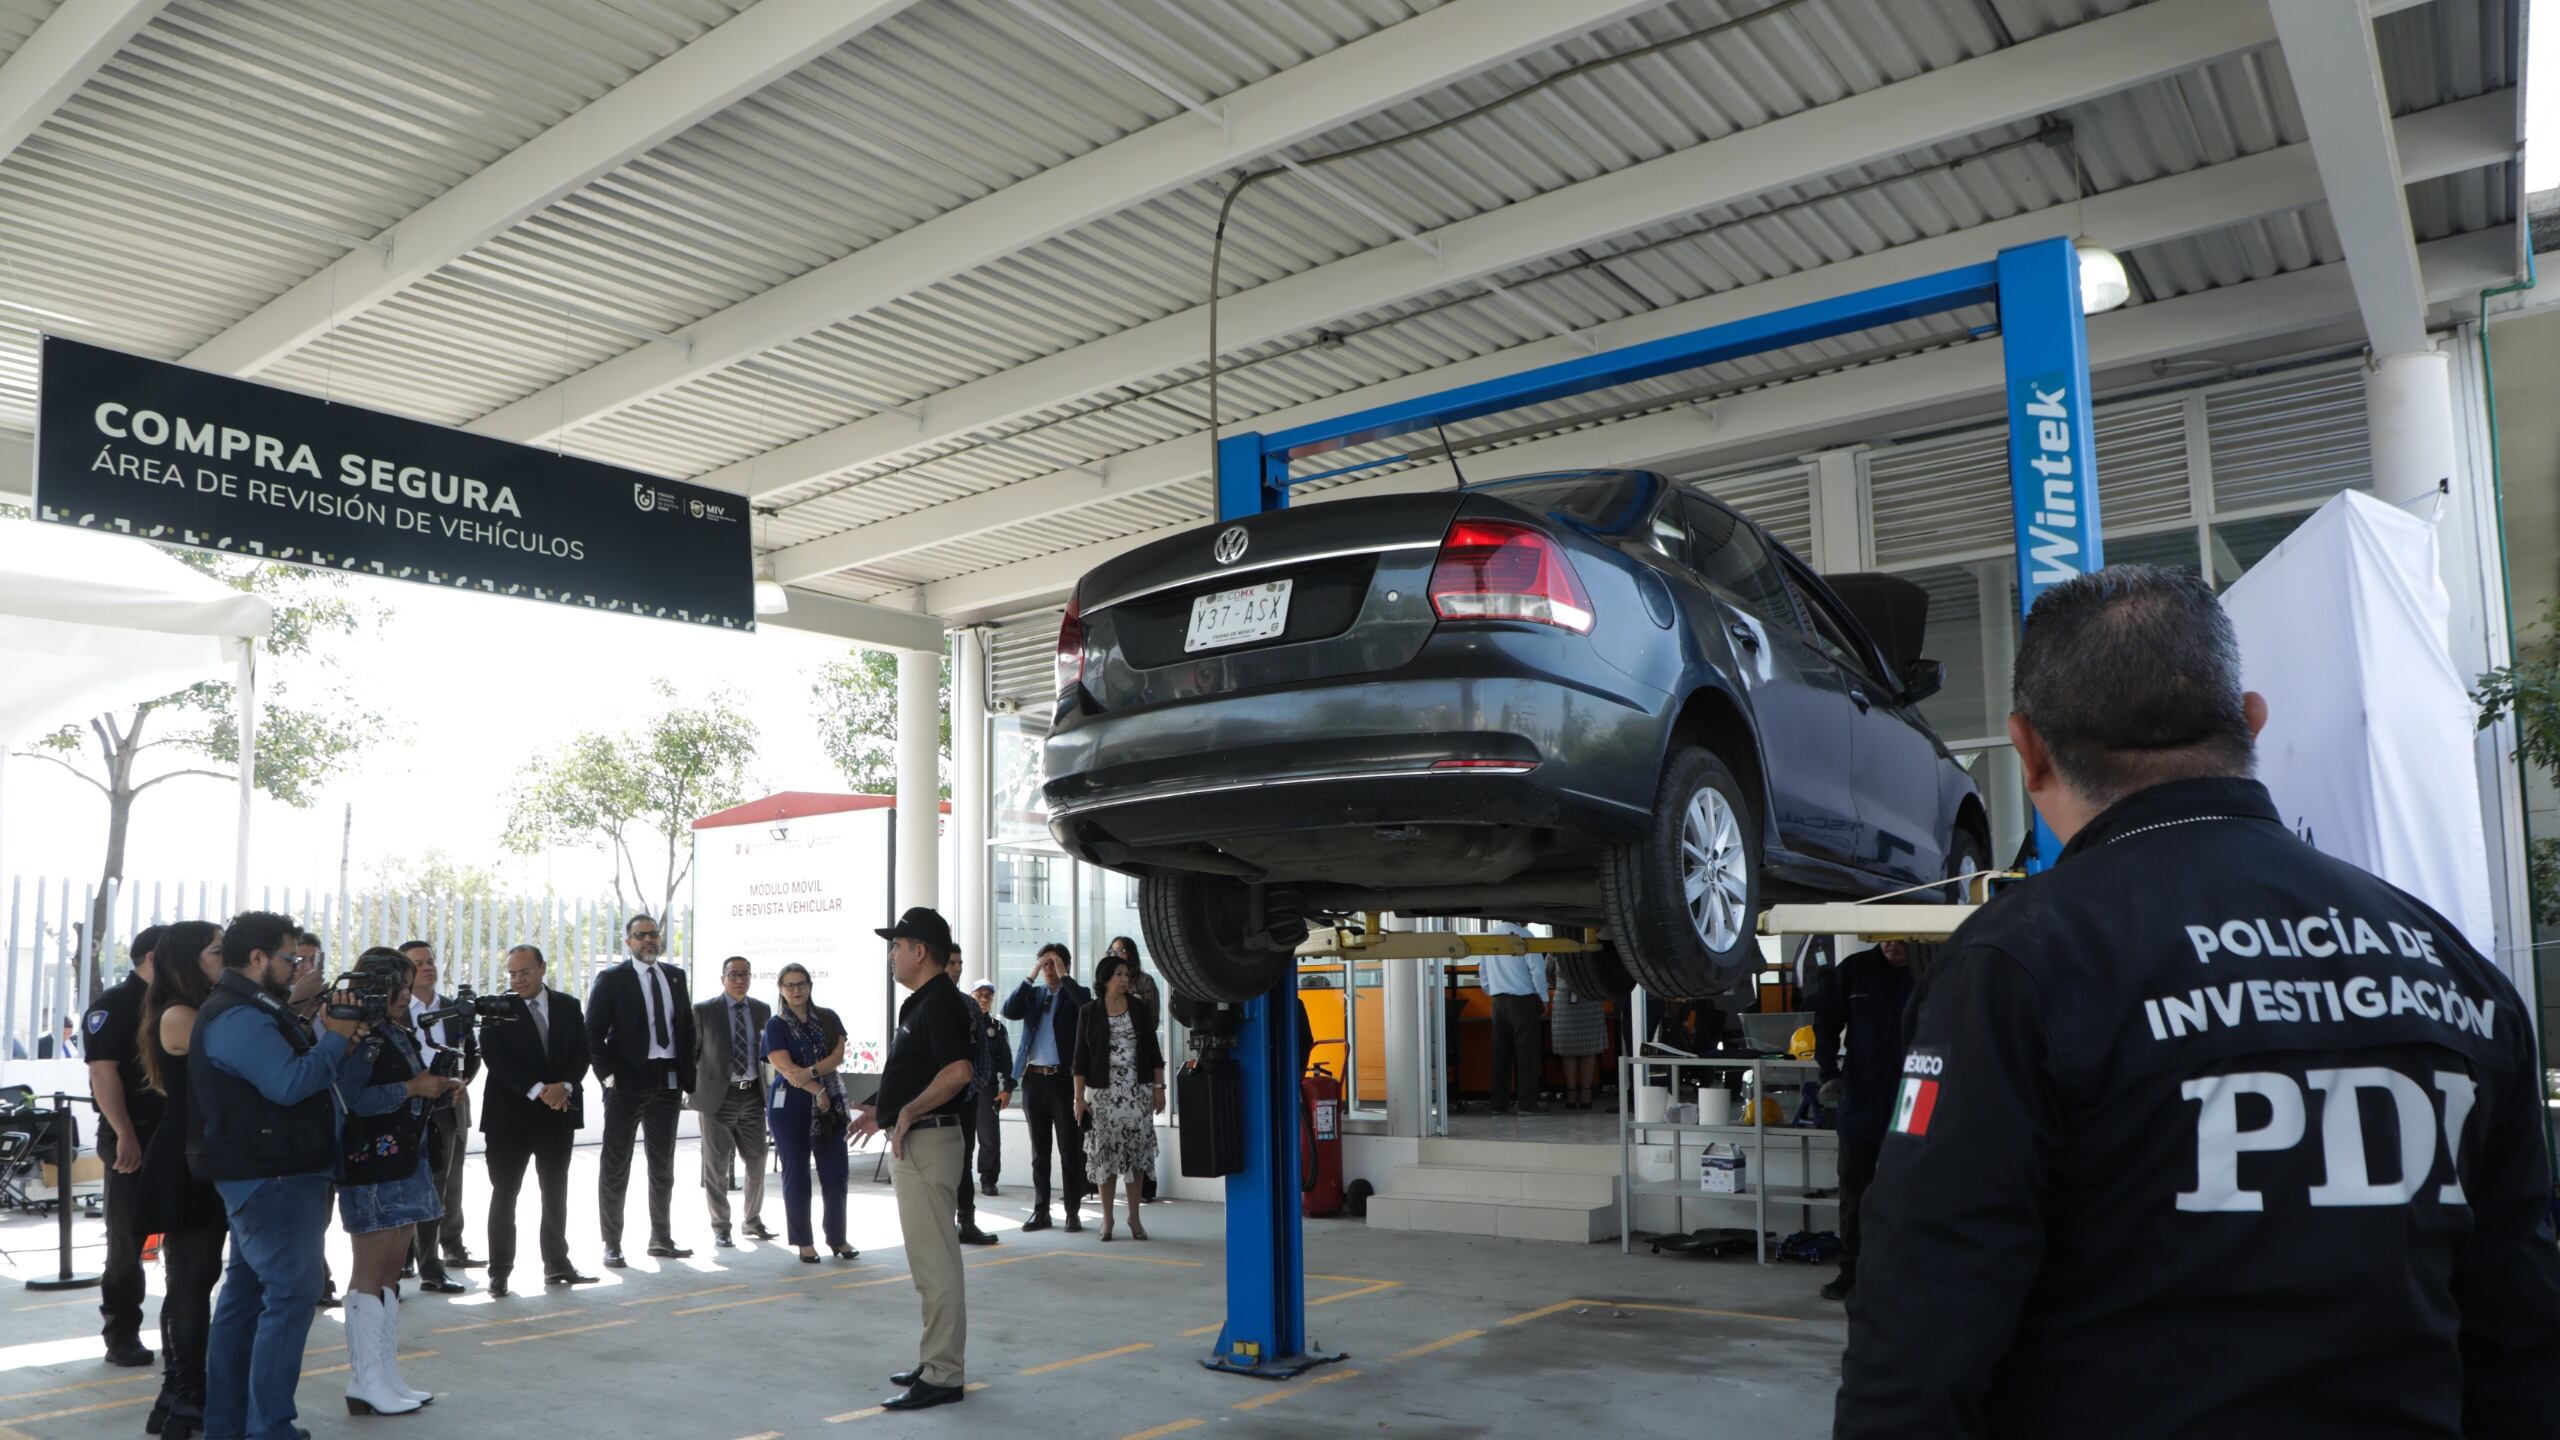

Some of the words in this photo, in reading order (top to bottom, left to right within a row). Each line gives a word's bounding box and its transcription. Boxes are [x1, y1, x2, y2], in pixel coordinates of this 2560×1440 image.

[94, 402, 323, 480] COMPRA
[339, 454, 521, 518] SEGURA
[92, 445, 185, 489] ÁREA
[196, 470, 238, 499] DE
[249, 479, 386, 526] REVISIÓN
[396, 508, 431, 536] DE
[439, 514, 585, 561] VEHÍCULOS
[706, 504, 725, 516] MIV
[2026, 387, 2080, 584] Wintek
[1196, 595, 1282, 633] Y37-ASX
[1227, 588, 1255, 601] CDMX
[732, 904, 743, 916] DE
[746, 902, 784, 916] REVISTA
[786, 898, 842, 914] VEHICULAR
[749, 880, 789, 896] MÓDULO
[792, 877, 823, 893] MÓVIL
[2184, 906, 2390, 964] POLICÍA
[2389, 923, 2444, 968] DE
[2144, 976, 2495, 1041] INVESTIGACIÓN
